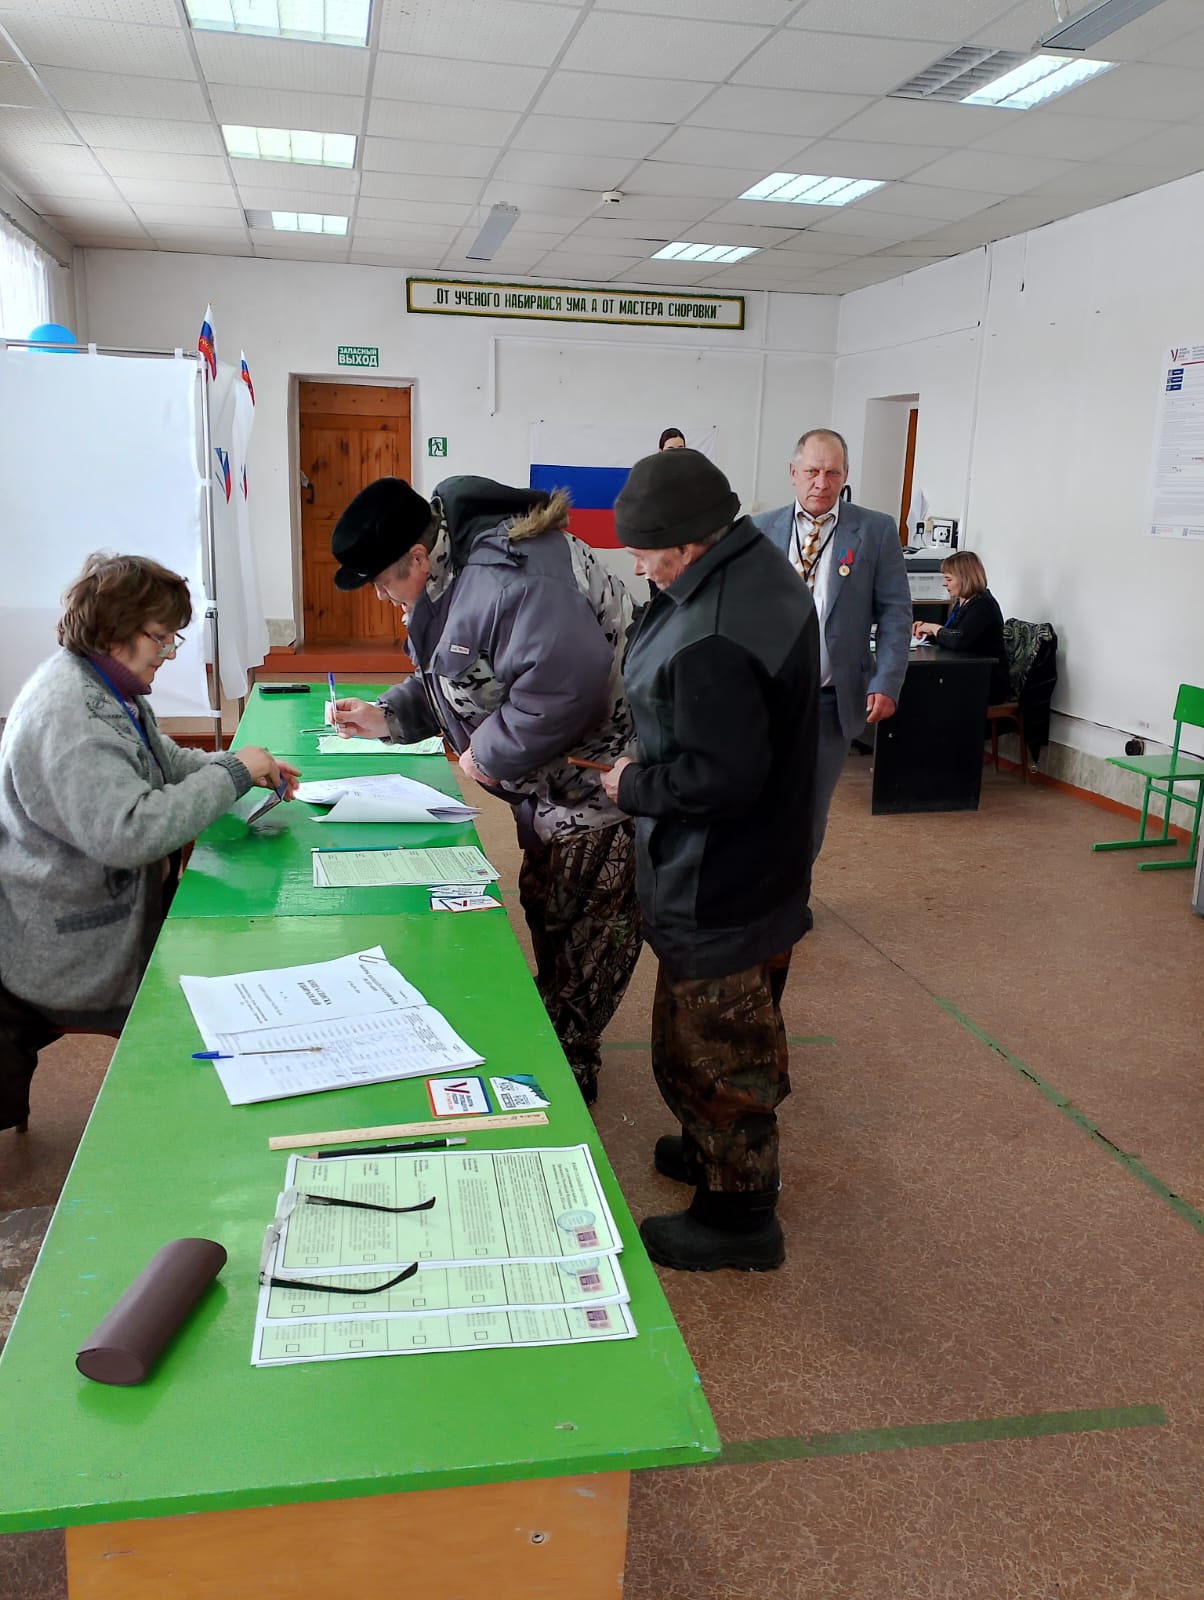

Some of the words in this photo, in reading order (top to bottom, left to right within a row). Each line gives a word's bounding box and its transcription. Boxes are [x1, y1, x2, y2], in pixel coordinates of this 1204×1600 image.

[455, 290, 500, 307] УЧЕНОГО
[591, 298, 598, 313] А
[602, 299, 614, 314] ОТ
[619, 300, 664, 316] МАСТЕРА
[339, 353, 377, 366] ВЫХОД
